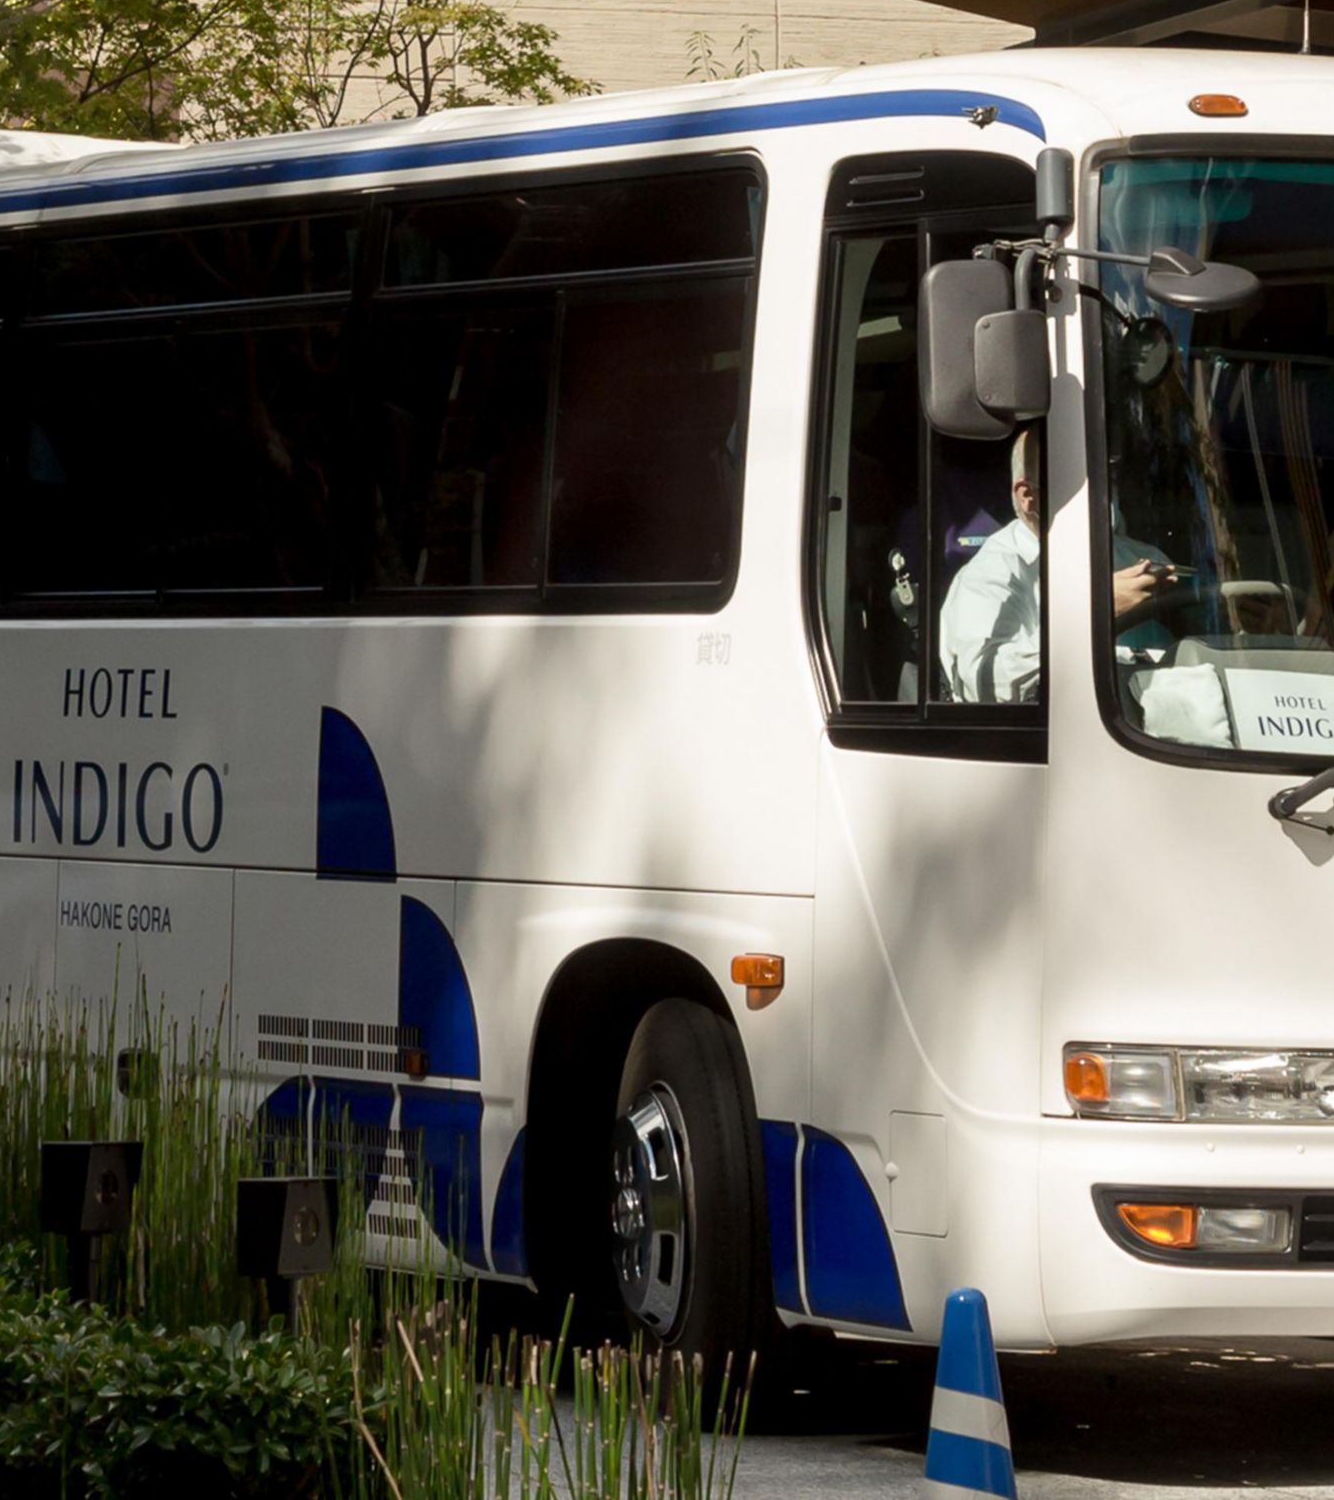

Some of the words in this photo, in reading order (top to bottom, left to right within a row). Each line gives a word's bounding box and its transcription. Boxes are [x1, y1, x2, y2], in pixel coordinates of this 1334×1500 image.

[696, 631, 732, 666] 貸切
[63, 667, 178, 718] HOTEL
[1274, 695, 1327, 711] HOTEL
[13, 759, 224, 854] INDIGO
[60, 900, 123, 930] HAKONE
[127, 903, 172, 933] GORA
